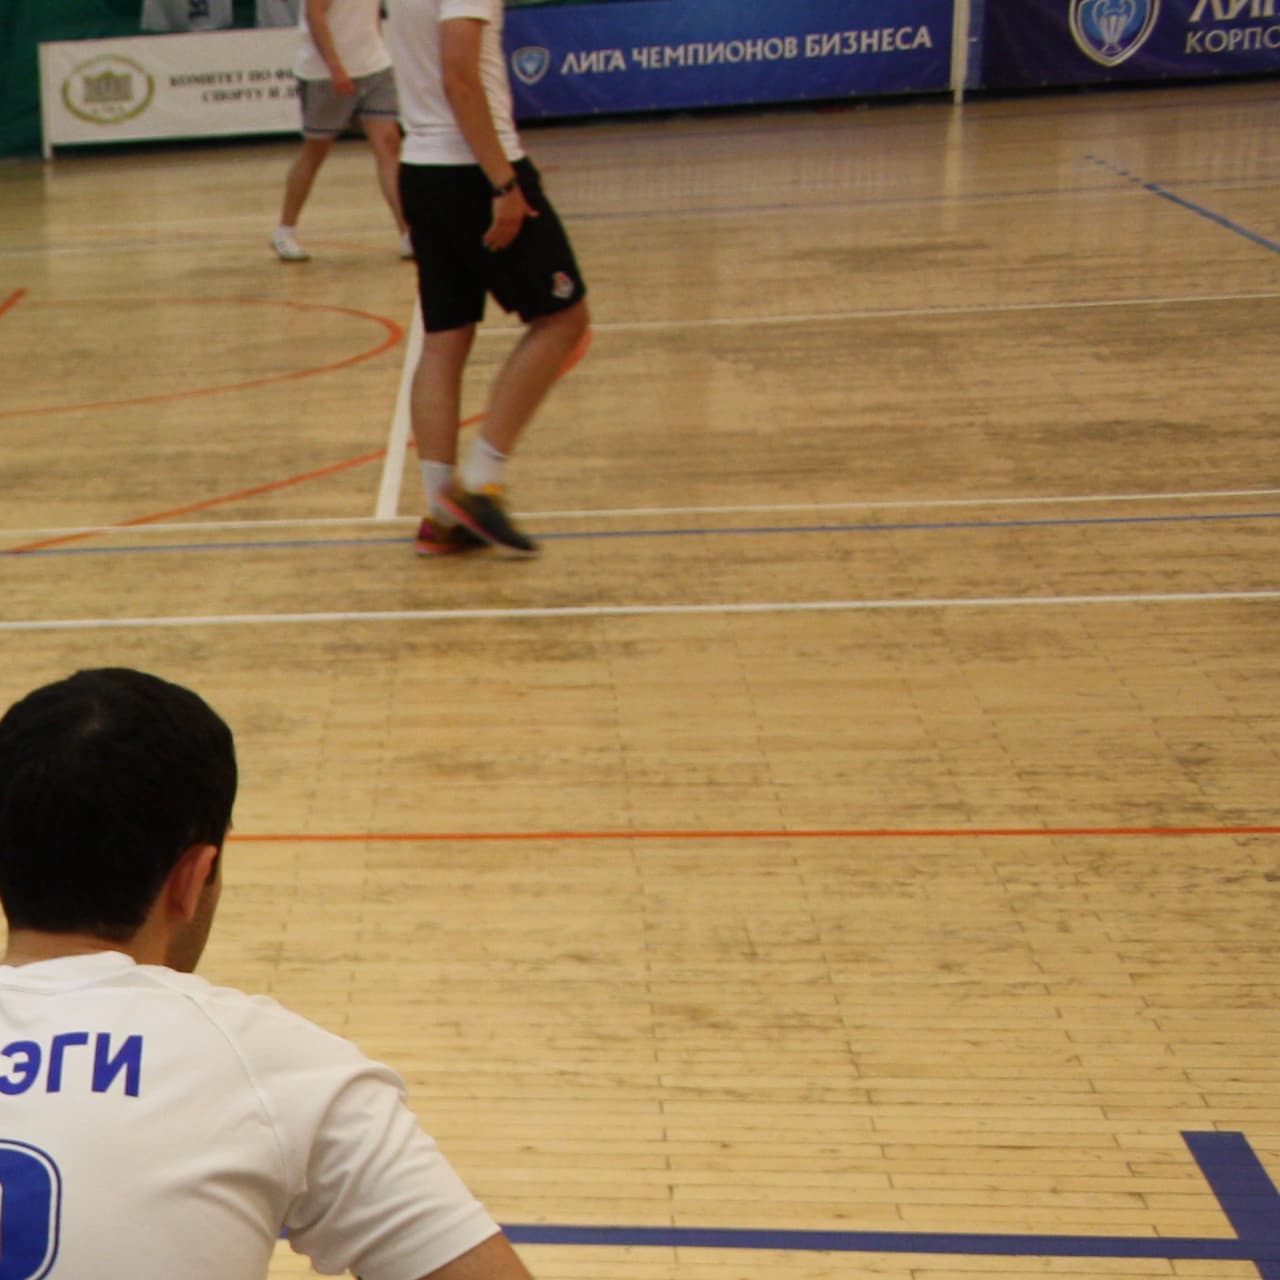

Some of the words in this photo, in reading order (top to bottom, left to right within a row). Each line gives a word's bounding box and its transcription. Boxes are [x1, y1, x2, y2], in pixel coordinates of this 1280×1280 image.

[560, 50, 626, 75] ЛИГА
[633, 37, 798, 69] ЧЕМПИОНОВ
[805, 25, 933, 58] БИЗНЕСА
